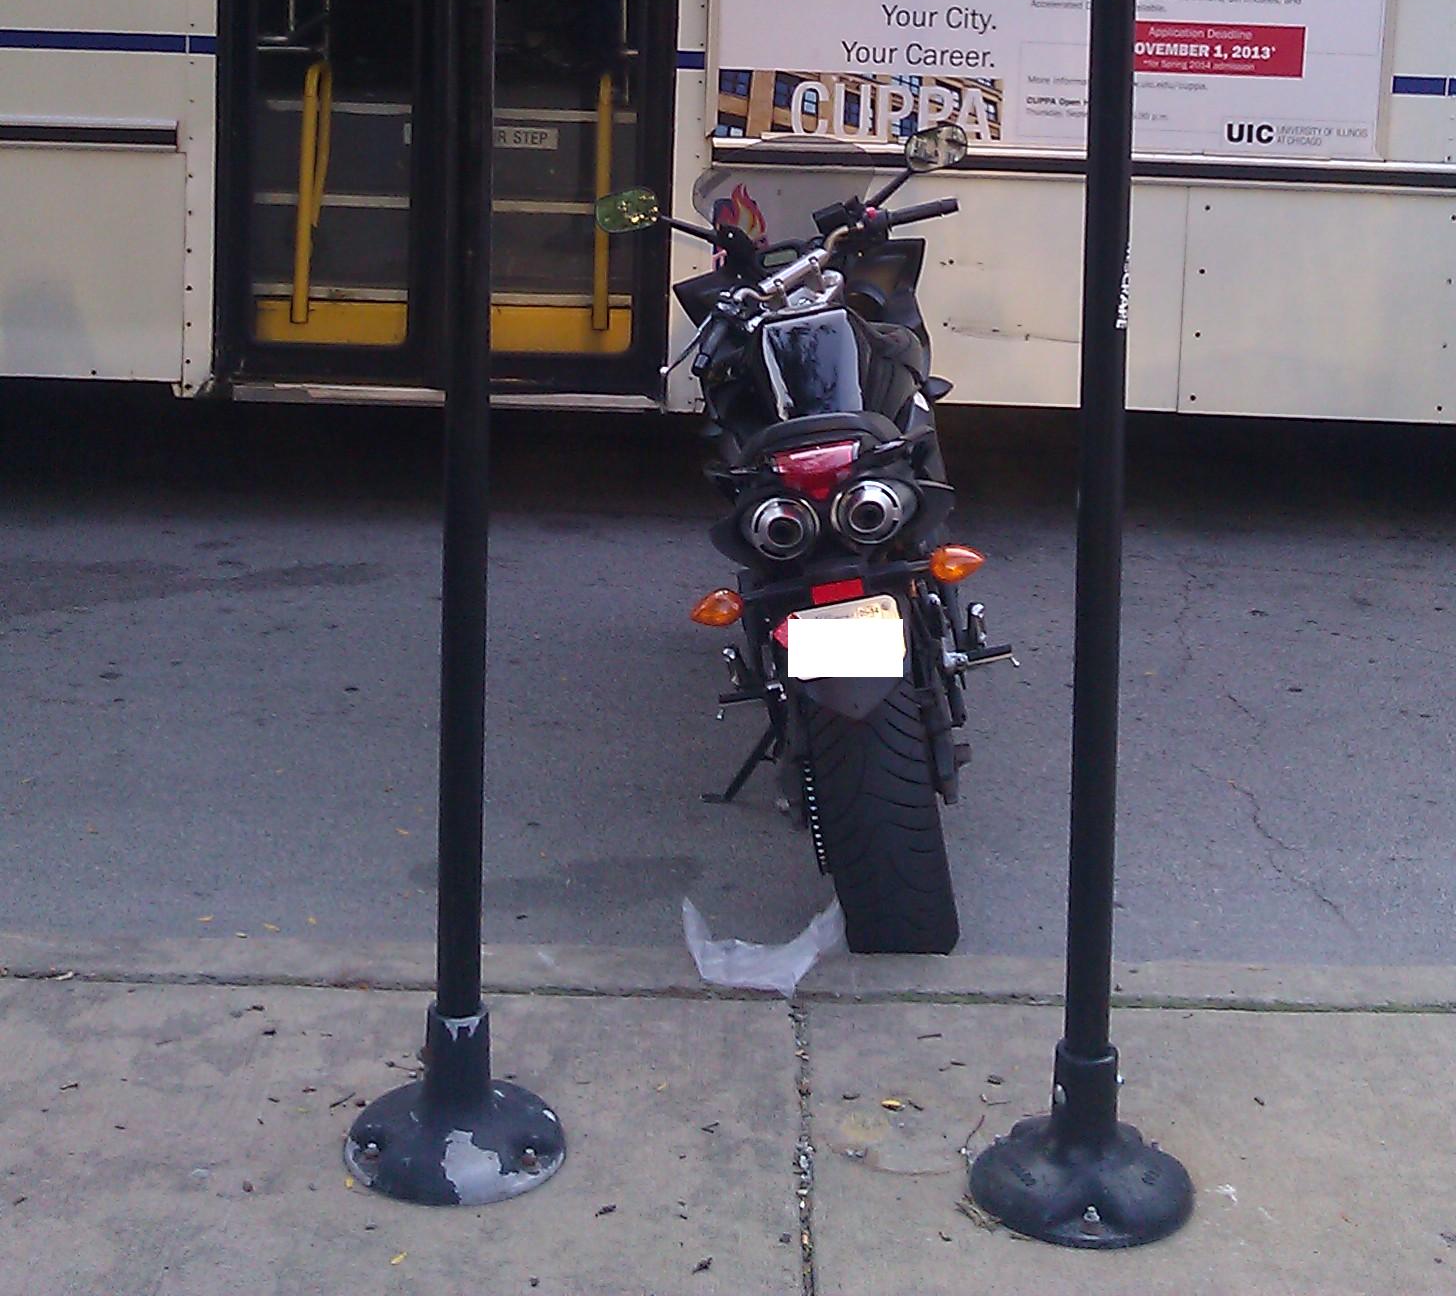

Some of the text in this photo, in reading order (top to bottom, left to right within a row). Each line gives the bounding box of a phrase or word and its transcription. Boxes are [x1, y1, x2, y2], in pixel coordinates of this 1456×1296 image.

[882, 4, 997, 35] Your City.
[1148, 27, 1253, 41] Application Deadline
[841, 40, 995, 68] Your Career.
[1134, 42, 1210, 58] OVEMBER
[1213, 45, 1229, 60] 1,
[1160, 60, 1188, 71] Spring
[1026, 96, 1056, 106] CUPPA
[791, 80, 994, 143] CUPPA
[513, 131, 549, 145] STEP
[1226, 123, 1368, 145] UIC UNIVERSITY OF ILLINOIS
[1276, 136, 1323, 147] AT CHICAGO
